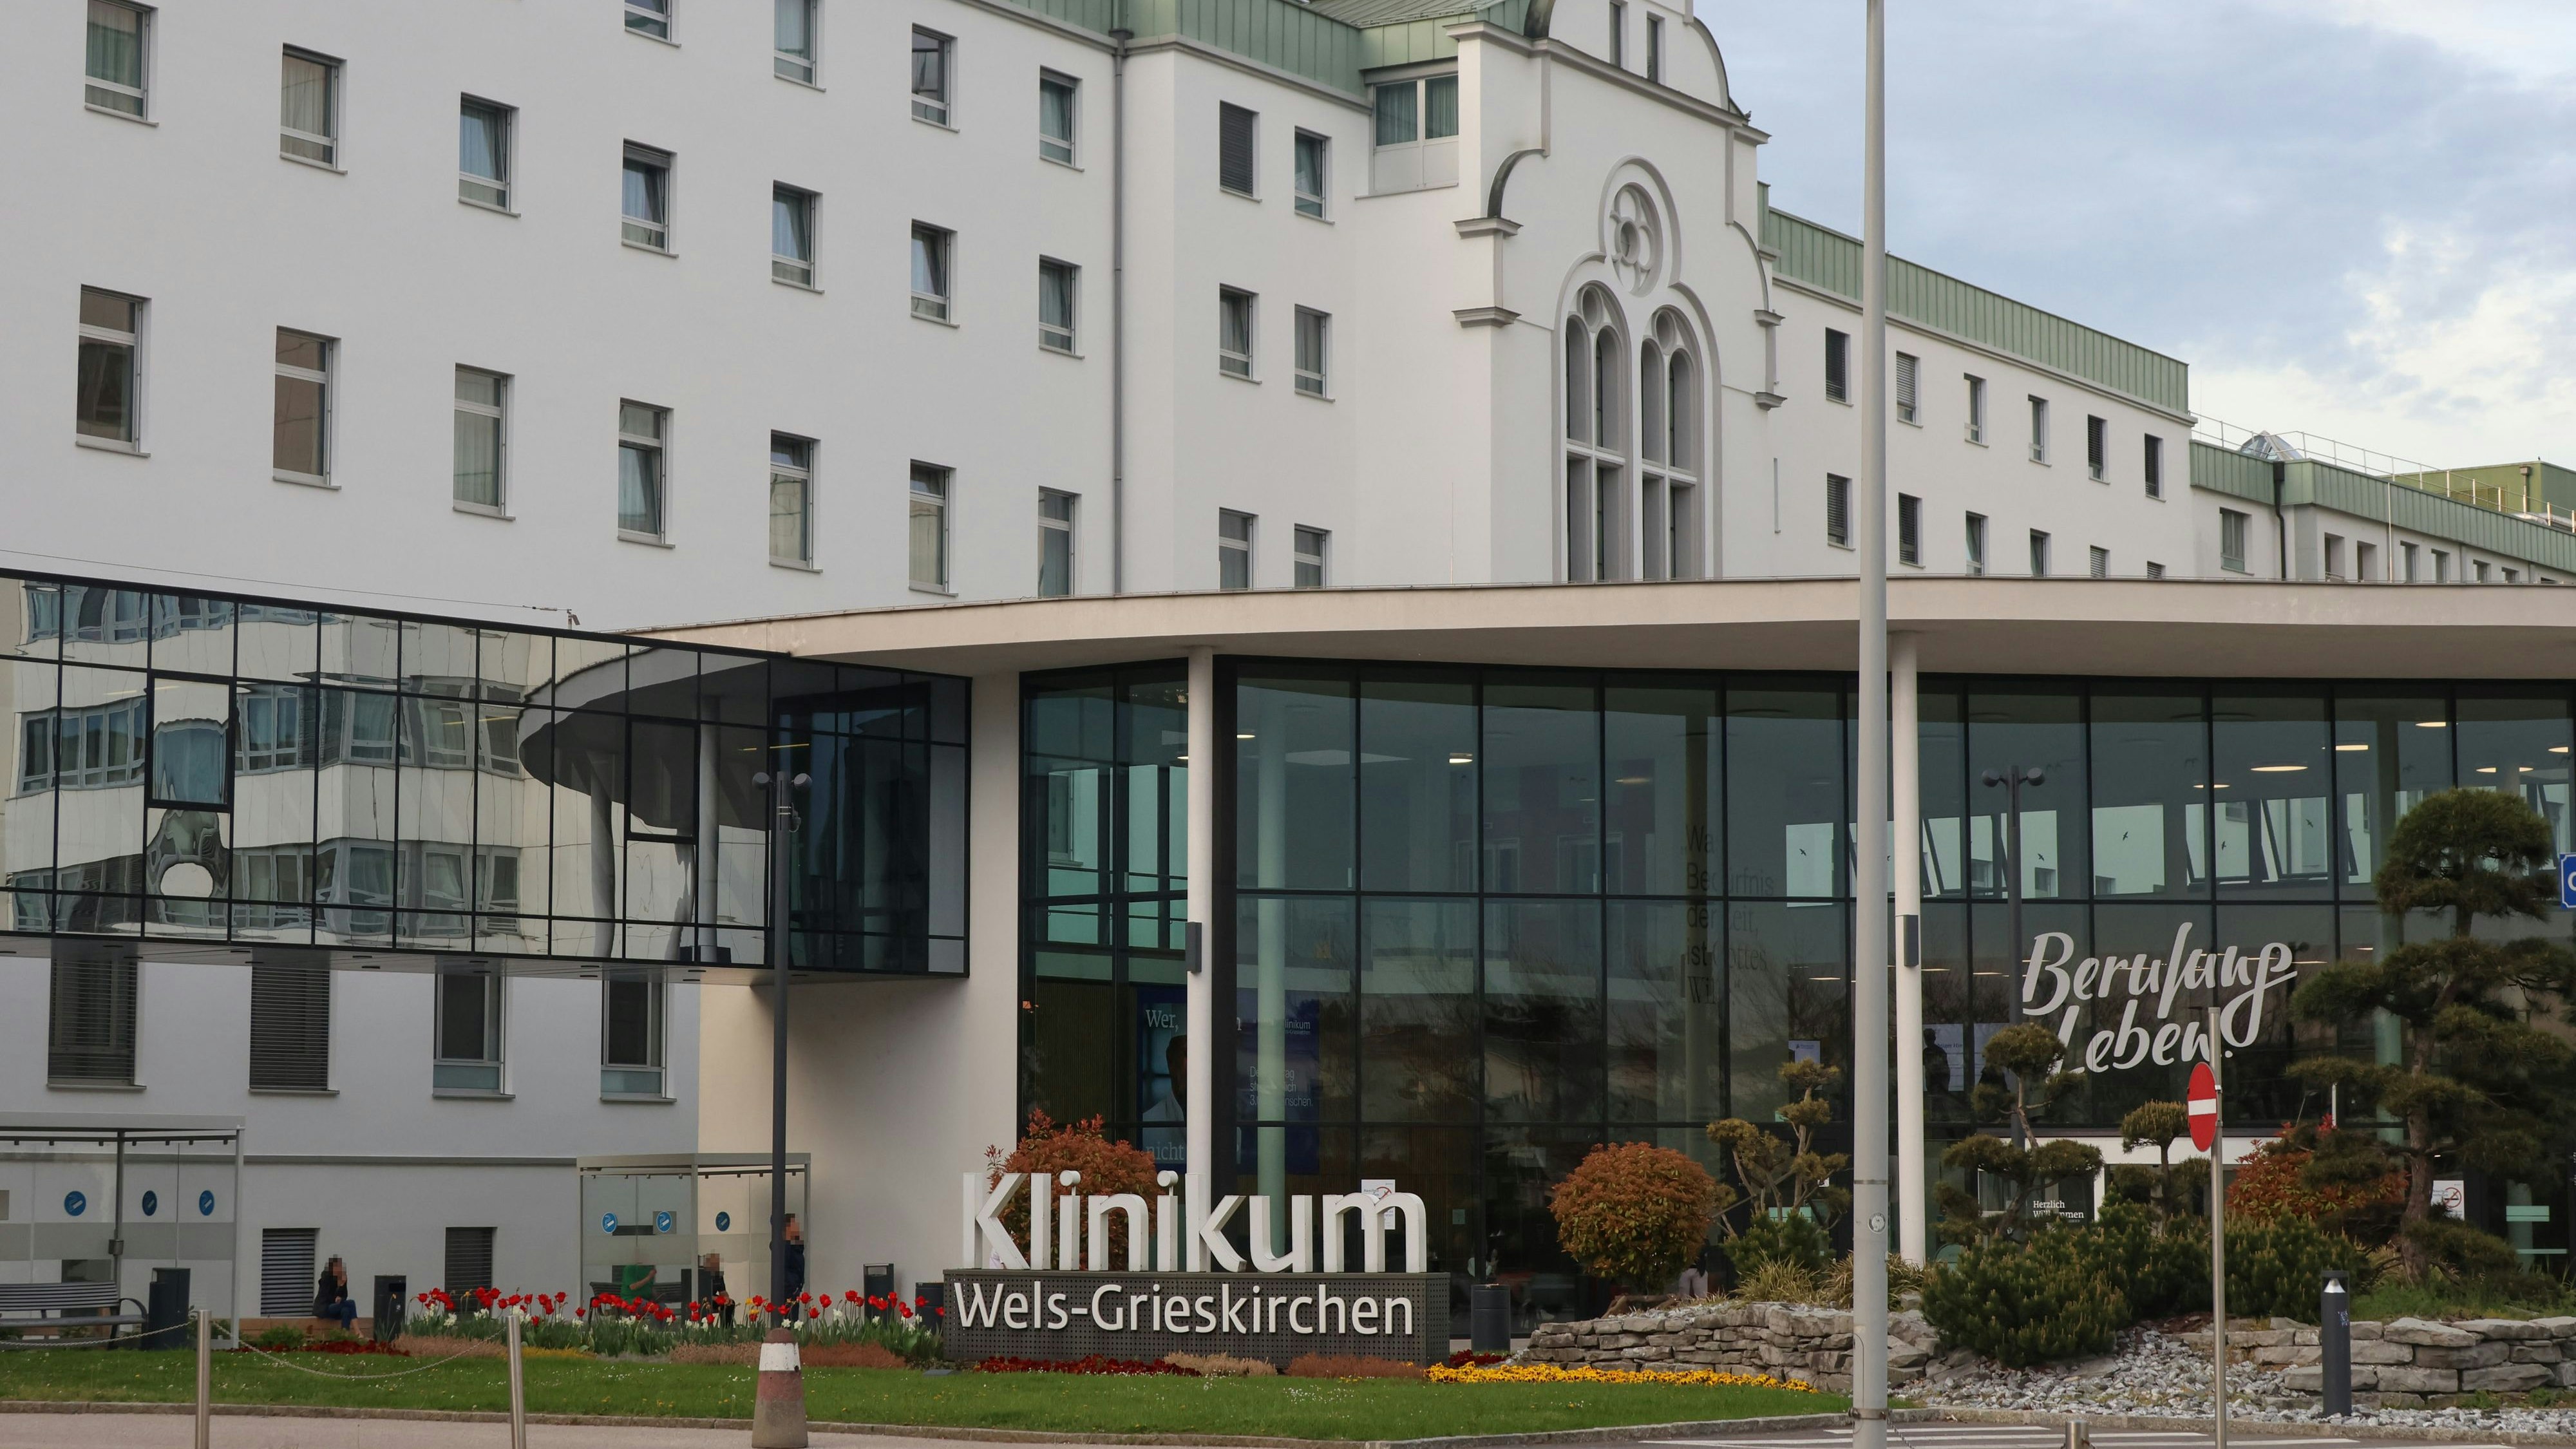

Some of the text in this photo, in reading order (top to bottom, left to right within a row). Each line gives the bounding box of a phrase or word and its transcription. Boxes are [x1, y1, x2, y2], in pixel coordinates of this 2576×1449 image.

[1730, 904, 1758, 938] eit,
[1687, 938, 1707, 966] ist
[2022, 922, 2297, 1047] Berufung
[1145, 1009, 1179, 1033] Wer,
[1285, 1019, 1311, 1030] linikum
[1285, 1095, 1313, 1107] nschen.
[963, 1170, 1426, 1273] Klinikum
[2033, 1209, 2085, 1218] Willmmen
[954, 1282, 1413, 1335] Wels-Grieskirchen
